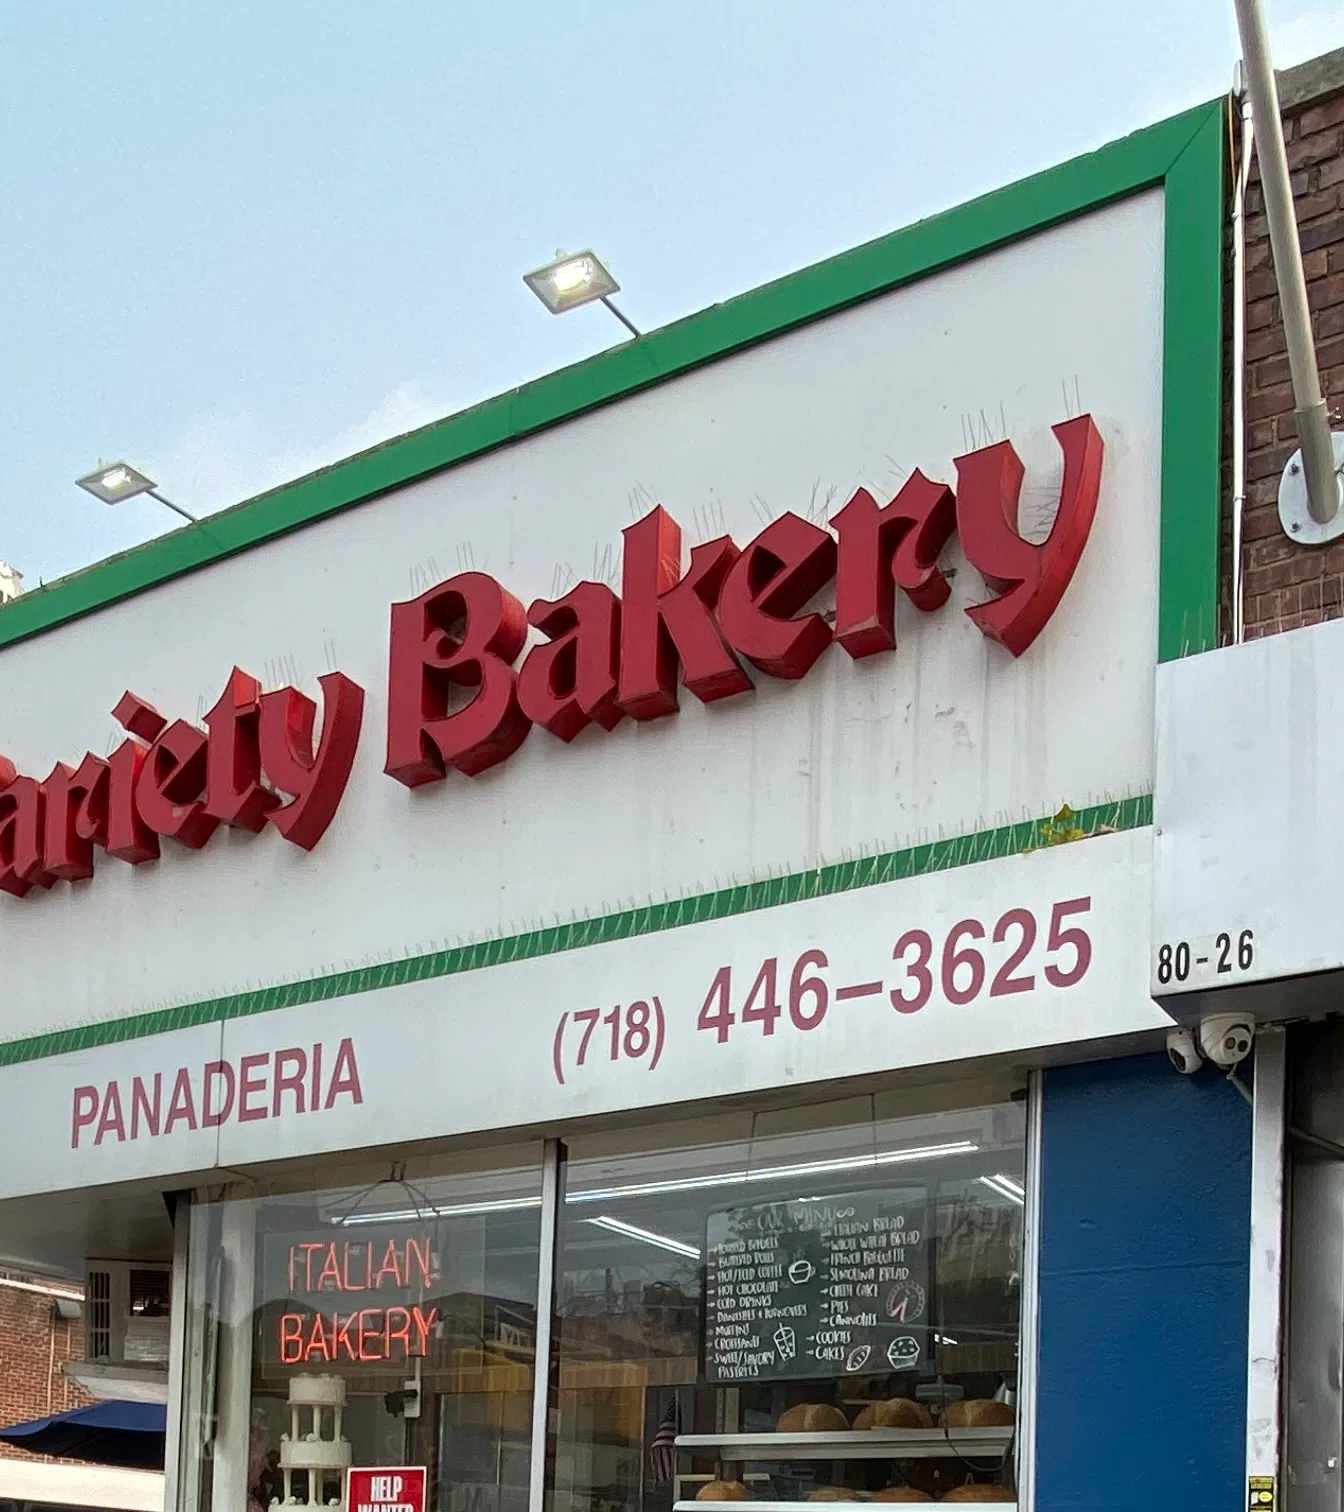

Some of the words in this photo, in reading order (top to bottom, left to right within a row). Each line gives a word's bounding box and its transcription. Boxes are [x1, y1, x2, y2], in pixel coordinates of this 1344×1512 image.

[383, 413, 1105, 790] Bakery
[1157, 928, 1255, 985] 80-26
[552, 995, 667, 1085] (718)
[696, 895, 1092, 1044] 446-3625
[70, 1037, 364, 1149] PANADERIA
[873, 1215, 905, 1232] BREAD
[890, 1230, 920, 1247] BREAD
[288, 1237, 432, 1292] ITALIAN
[758, 1264, 783, 1279] COFFEE
[878, 1267, 910, 1281] BREAD
[717, 1284, 733, 1297] HOT
[736, 1281, 779, 1295] CHOCOLATE
[717, 1295, 736, 1309] COLD
[739, 1294, 773, 1308] DRINKS
[280, 1306, 438, 1364] BAKERY
[816, 1331, 851, 1344] COOKIES
[815, 1346, 844, 1361] CAKES
[370, 1476, 403, 1502] HELP
